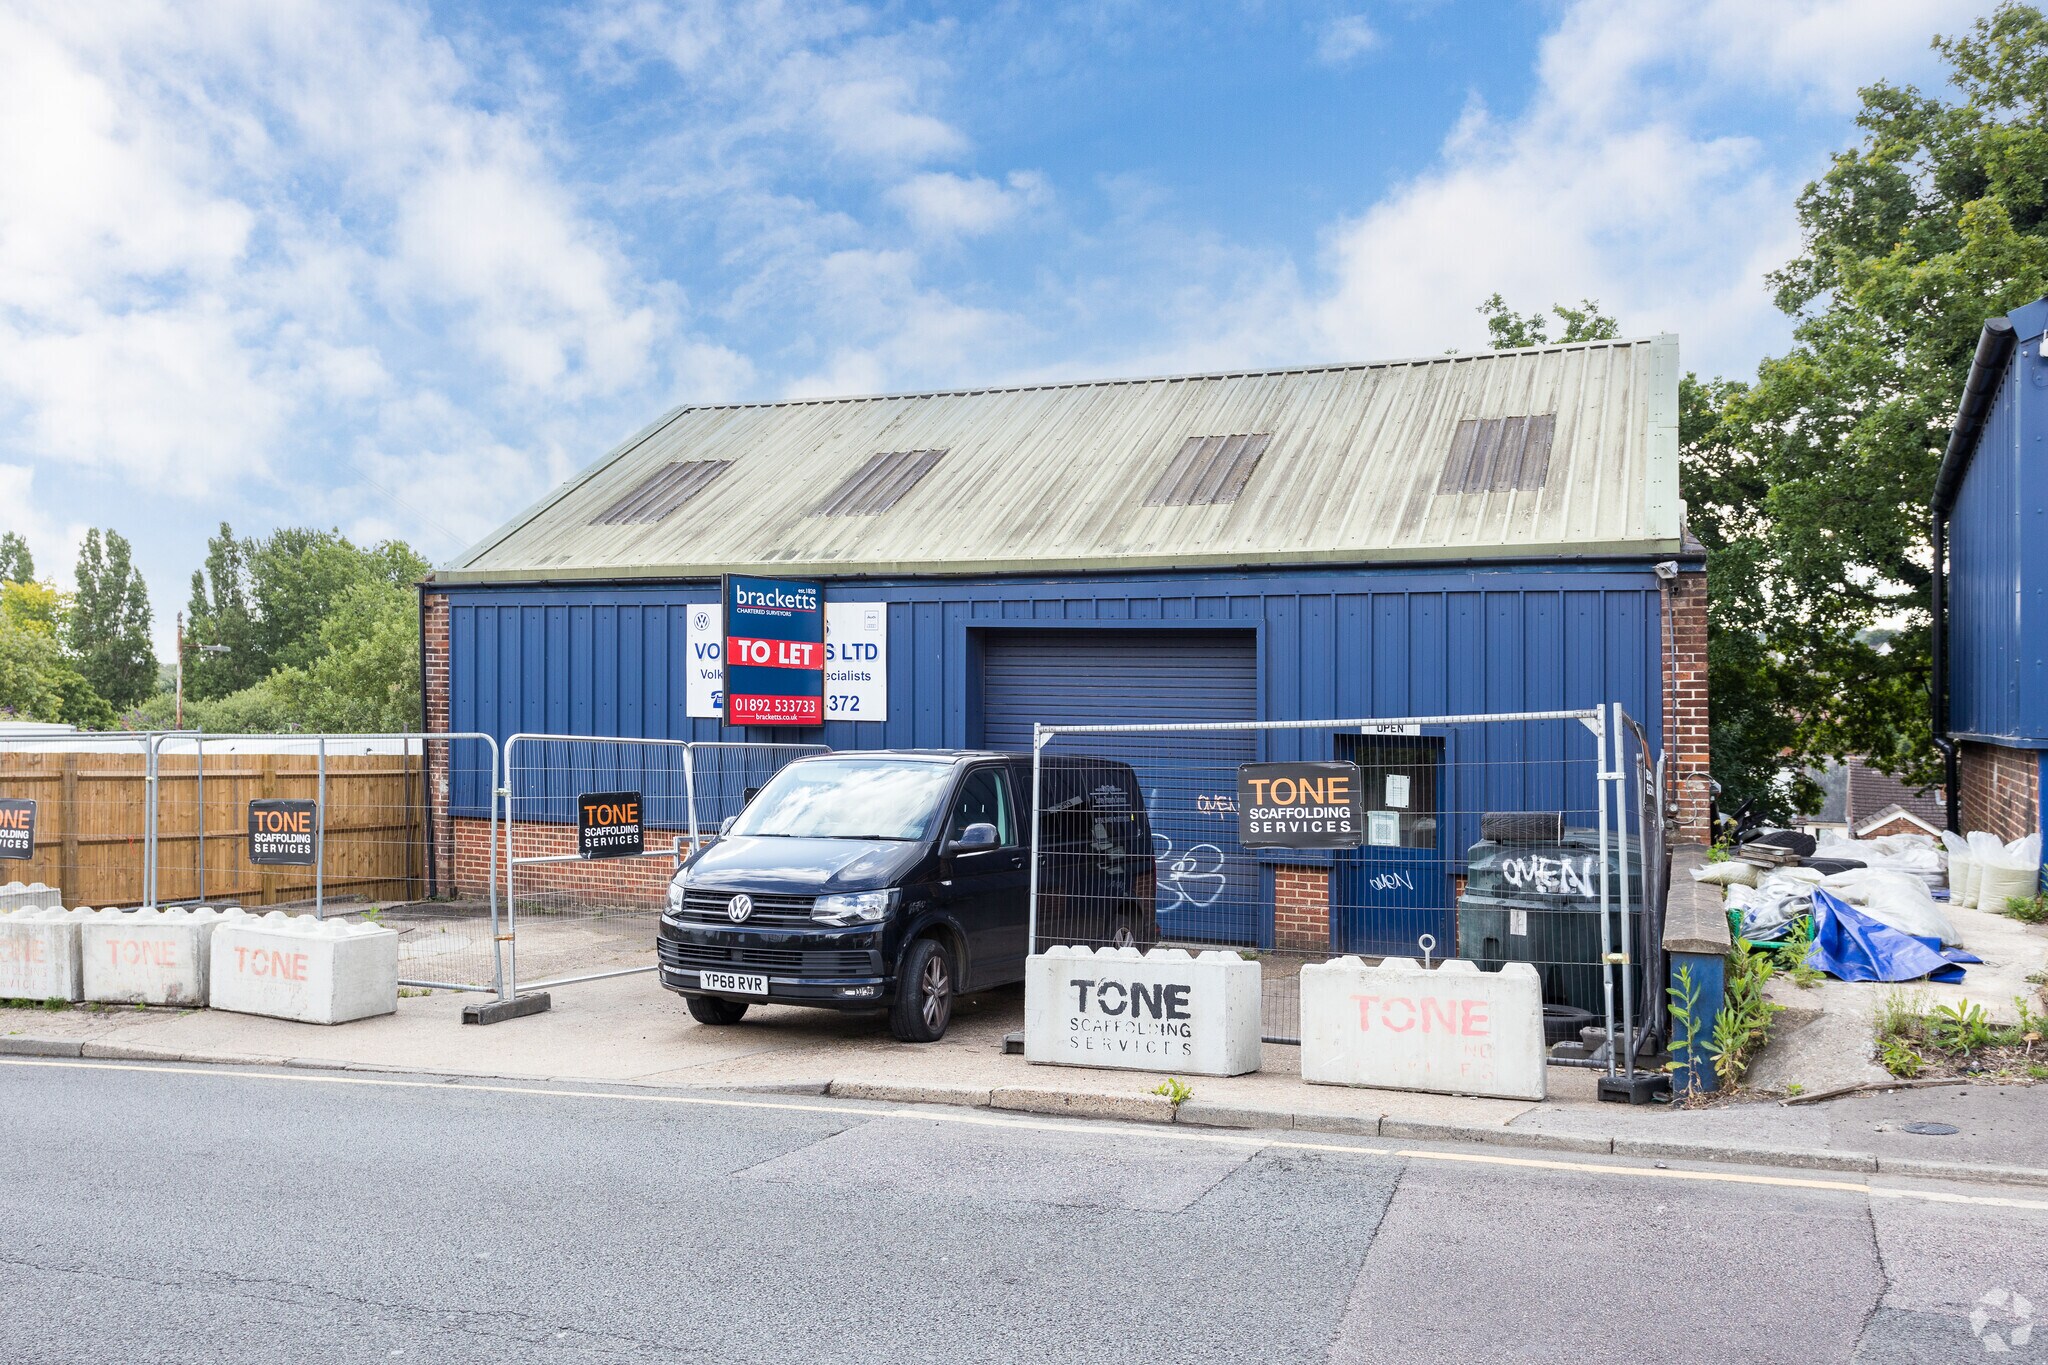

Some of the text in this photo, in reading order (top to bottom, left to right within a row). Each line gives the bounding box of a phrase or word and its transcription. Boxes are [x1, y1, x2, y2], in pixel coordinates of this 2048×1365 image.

[736, 584, 817, 610] bracketts
[736, 607, 792, 617] CHARTERED SURVEYORS
[738, 639, 813, 666] TO LET
[842, 643, 878, 661] LTD
[735, 698, 815, 713] 01892 533733
[826, 695, 860, 712] 372
[755, 713, 798, 721] bracketts.co.uk
[1377, 724, 1404, 733] OPEN
[1247, 777, 1350, 806] TONE
[254, 811, 311, 833] TONE
[583, 803, 639, 826] TONE
[1249, 806, 1351, 820] SCAFFOLDING
[584, 824, 639, 837] SCAFFOLDING
[1249, 820, 1351, 833] SERVICES
[254, 833, 311, 843] SCAFFOLDING
[585, 835, 639, 847] SERVICES
[254, 843, 311, 854] SERVICES
[106, 940, 177, 967] TONE
[233, 946, 309, 981] TONE
[705, 973, 762, 992] YP68 RVR
[1070, 978, 1191, 1020] TONE
[1350, 995, 1490, 1036] TONE
[1070, 1018, 1192, 1038] SCAFFOLDING
[1070, 1036, 1192, 1056] SERVICES
